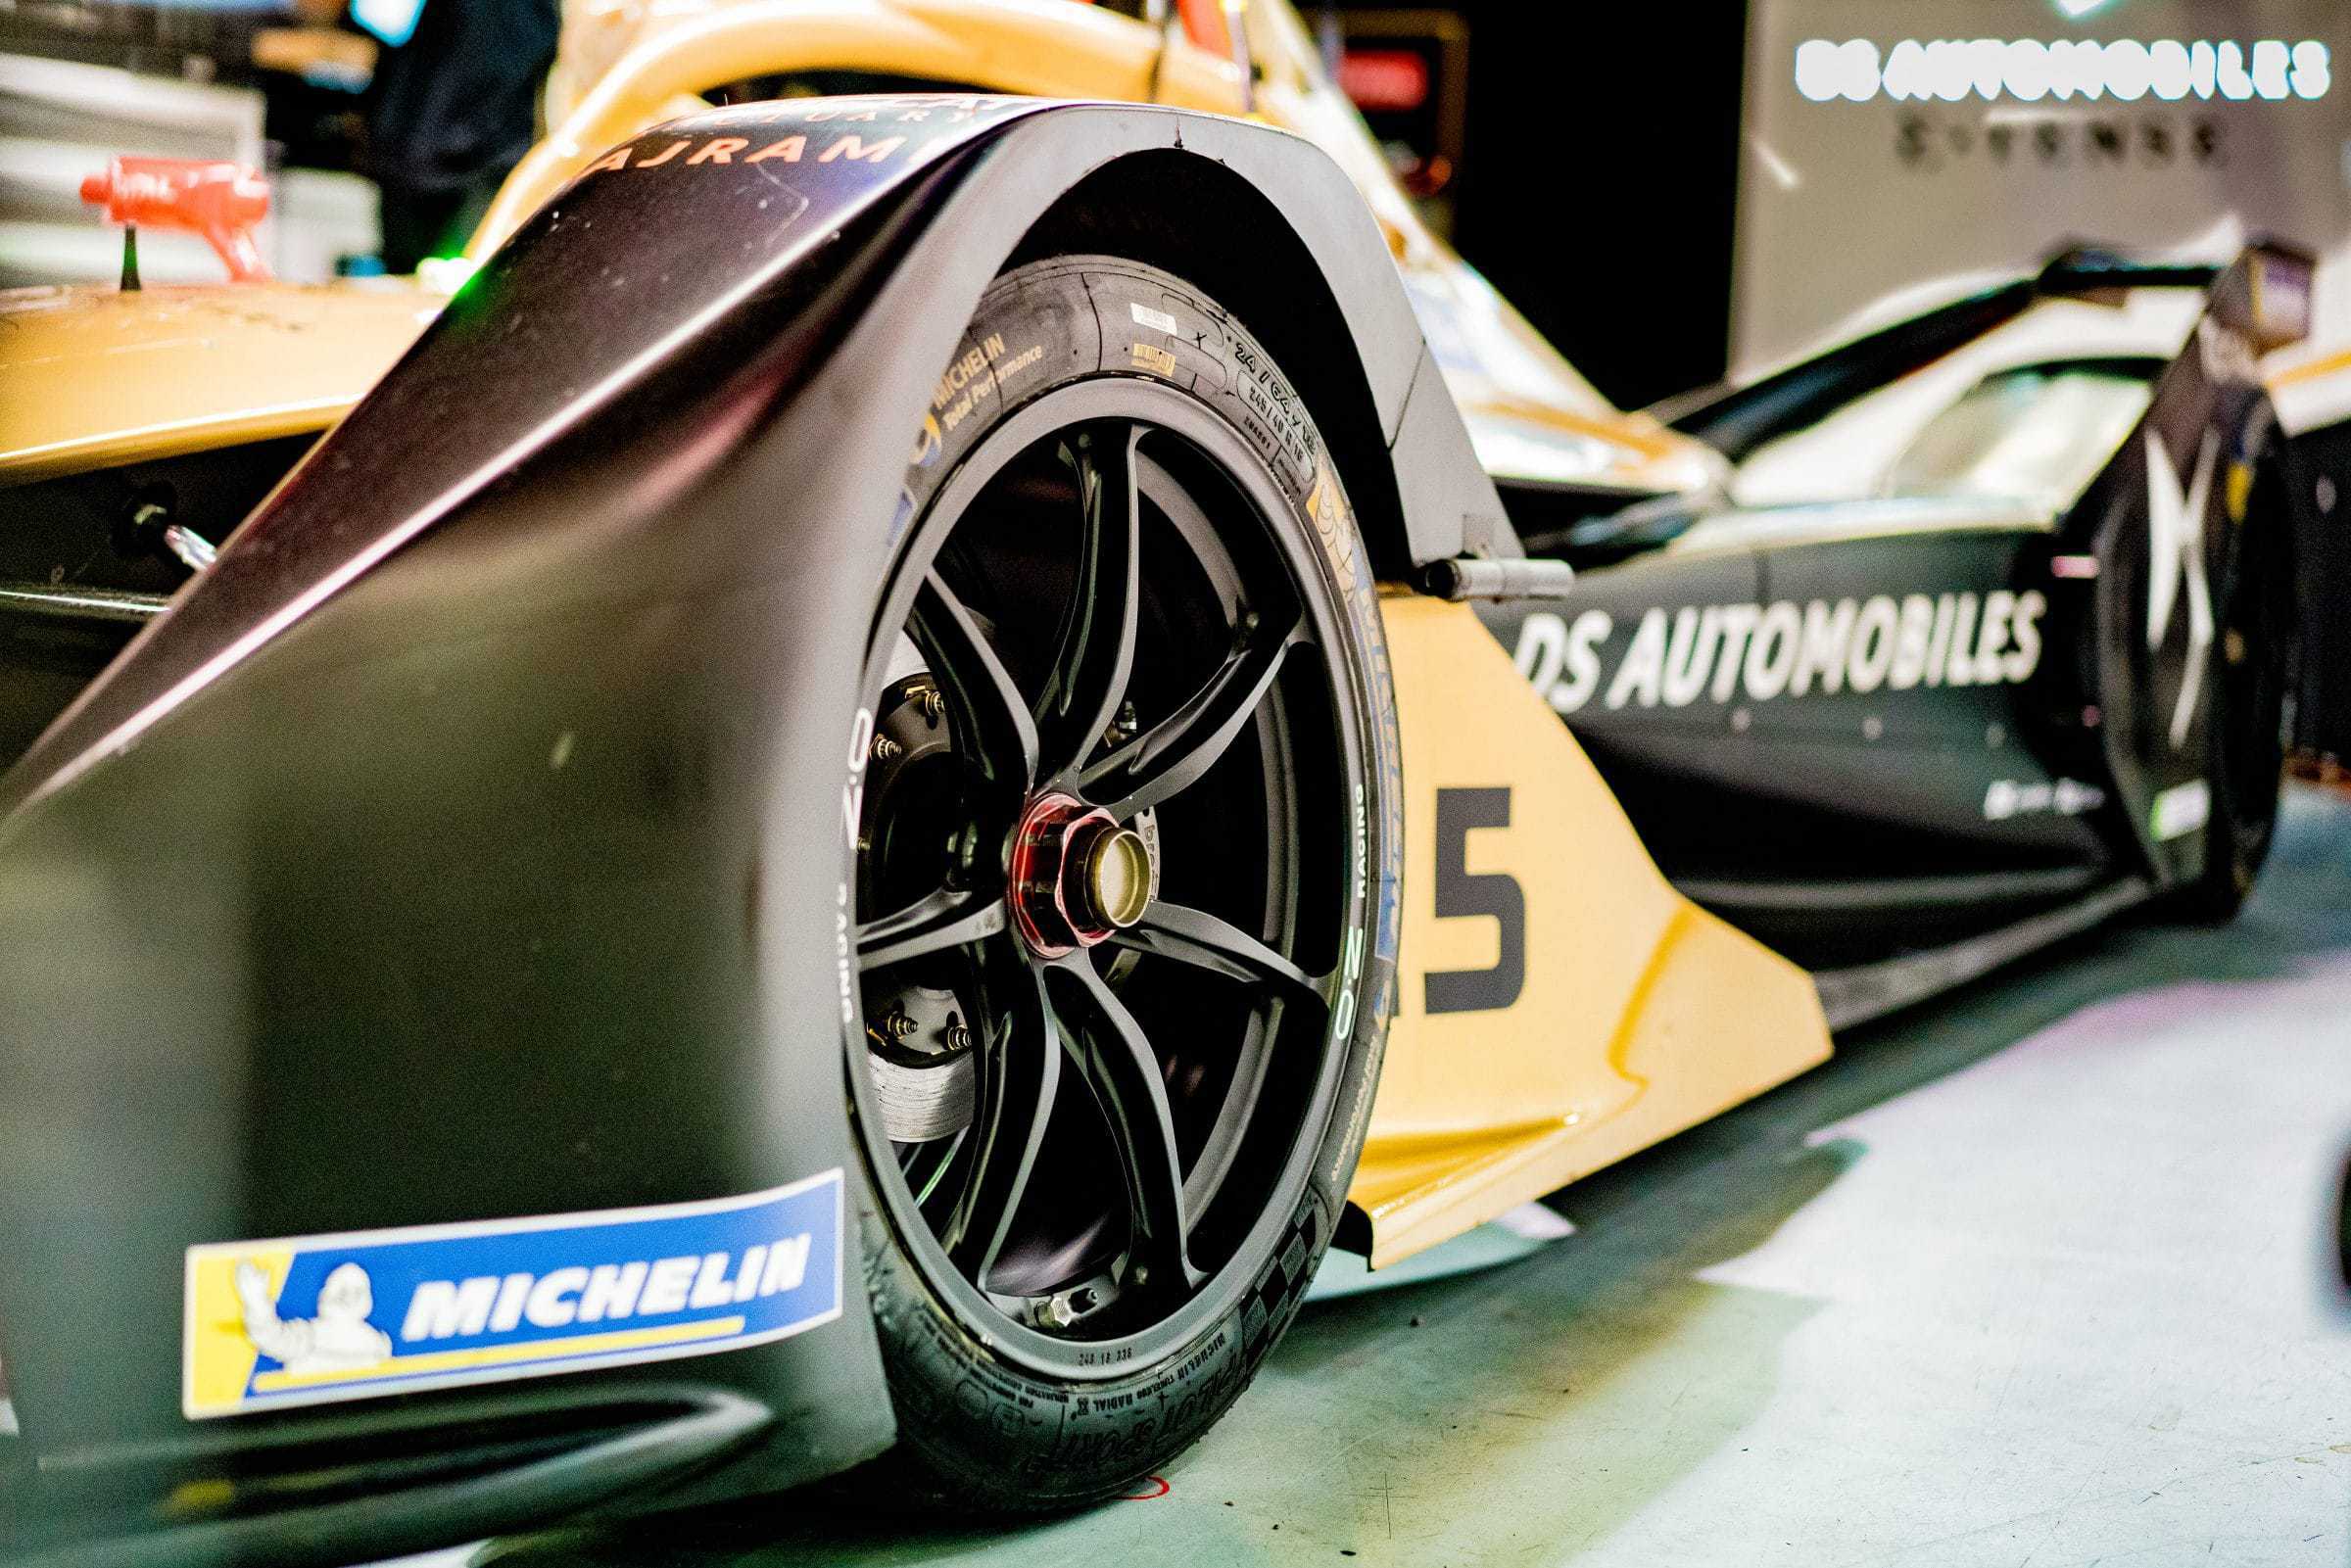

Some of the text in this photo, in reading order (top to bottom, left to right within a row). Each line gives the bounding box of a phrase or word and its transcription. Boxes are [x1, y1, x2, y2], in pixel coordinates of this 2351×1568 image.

[932, 332, 1006, 410] MICHELIN
[941, 344, 1043, 432] Total Performance
[1514, 590, 2047, 714] DS AUTOMOBILES
[1355, 784, 1367, 899] RACING
[1389, 786, 1526, 1016] 5
[400, 1232, 812, 1343] MICHELIN
[1092, 1393, 1133, 1412] RADIAL
[1177, 1332, 1226, 1381] MICHELIN
